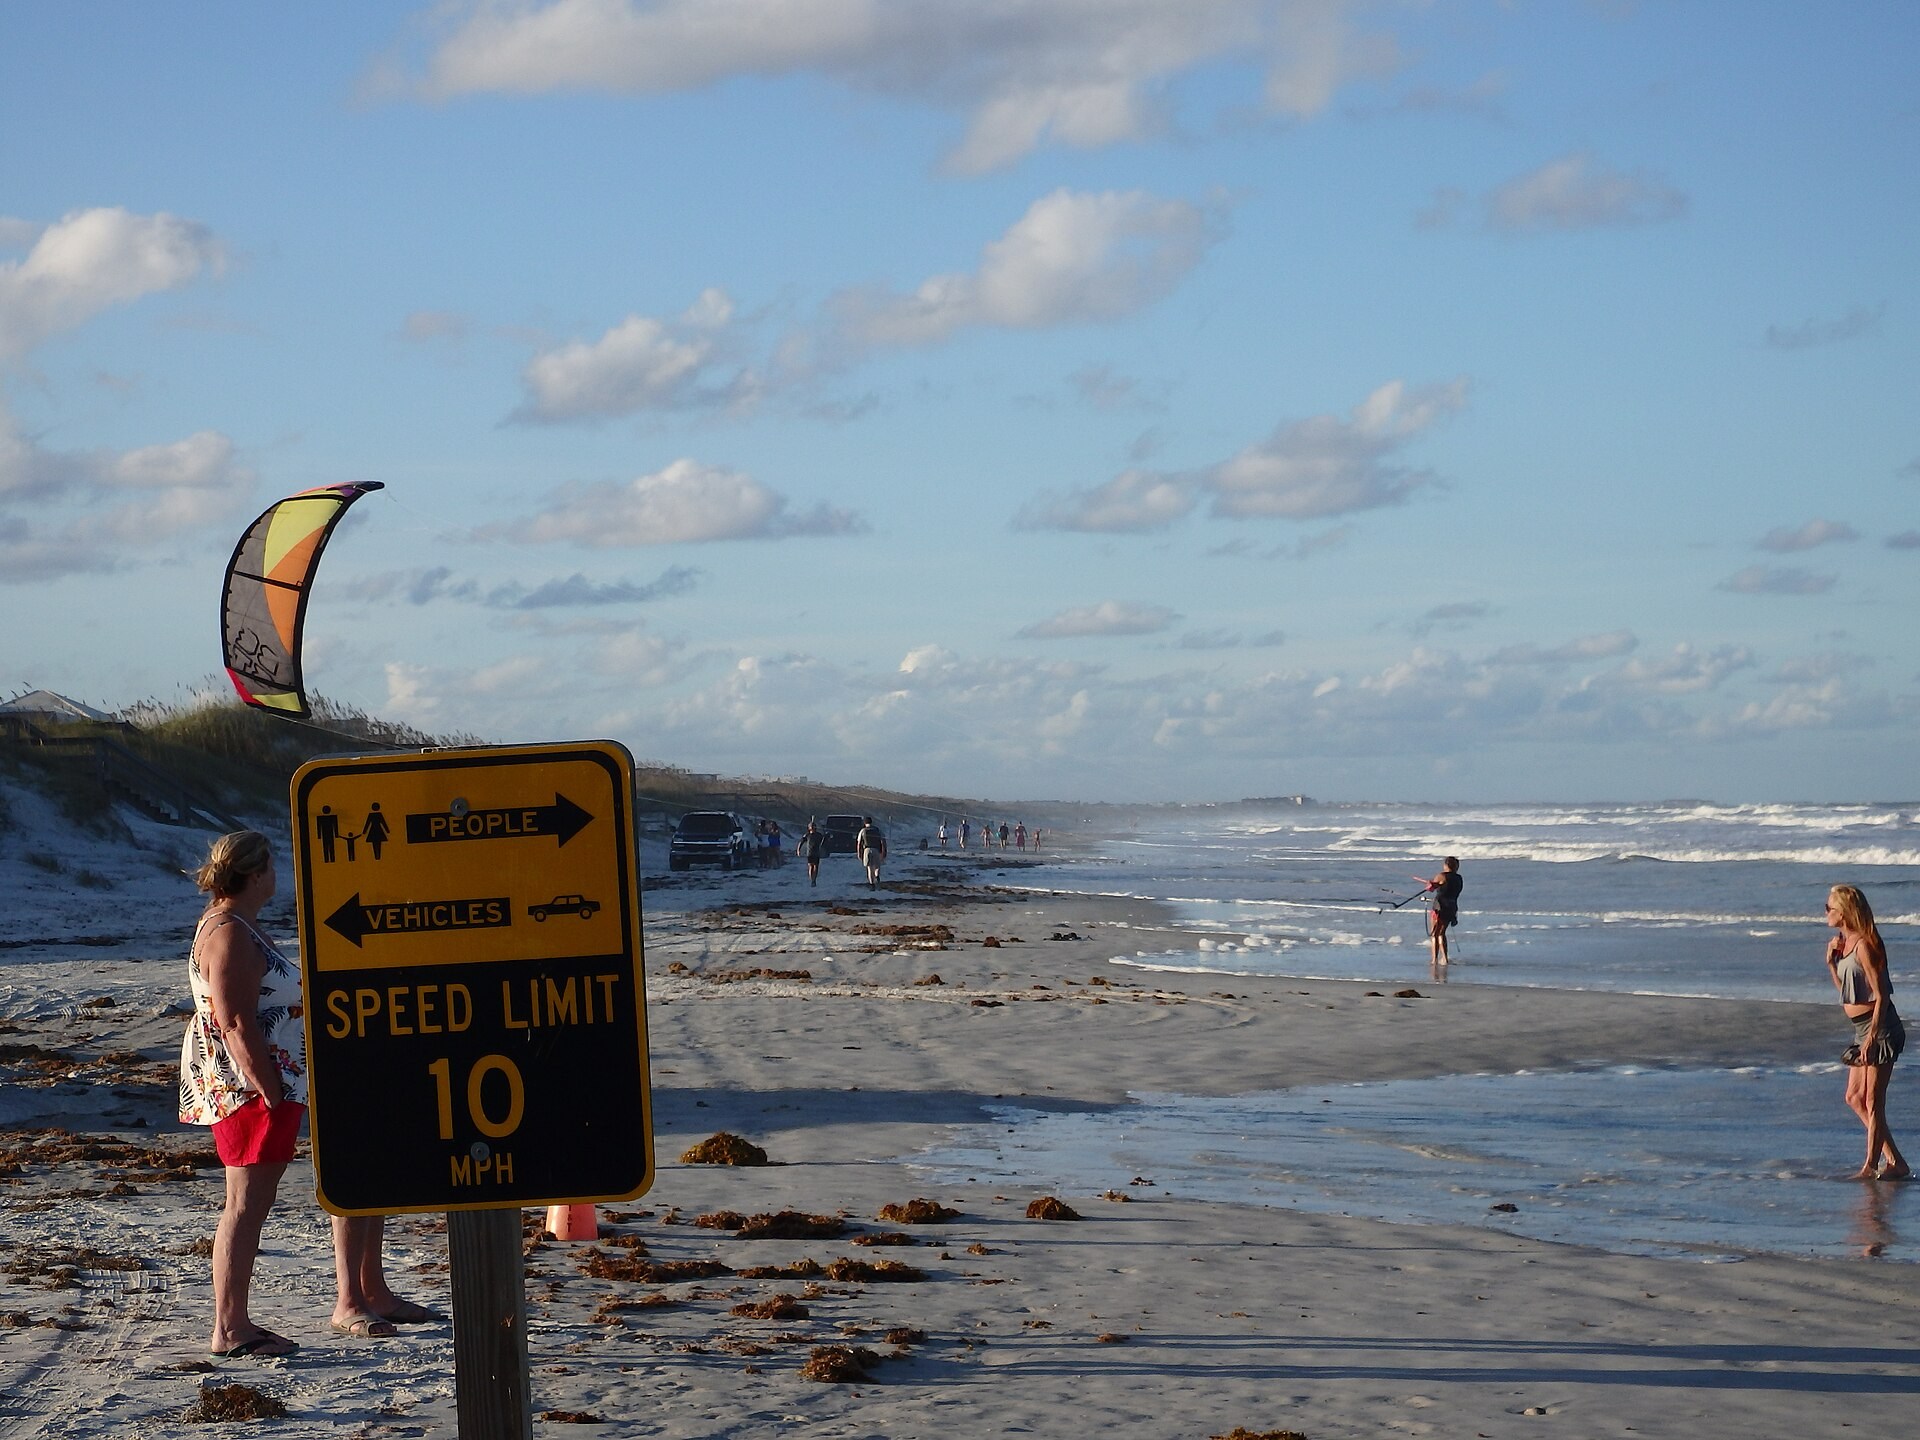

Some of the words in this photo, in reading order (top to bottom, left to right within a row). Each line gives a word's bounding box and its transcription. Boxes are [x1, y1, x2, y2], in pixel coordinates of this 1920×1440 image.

[430, 811, 539, 838] PEOPLE
[366, 902, 503, 929] VEHICLES
[326, 983, 473, 1039] SPEED
[502, 974, 620, 1030] LIMIT
[428, 1054, 525, 1140] 10
[450, 1152, 514, 1187] MPH
